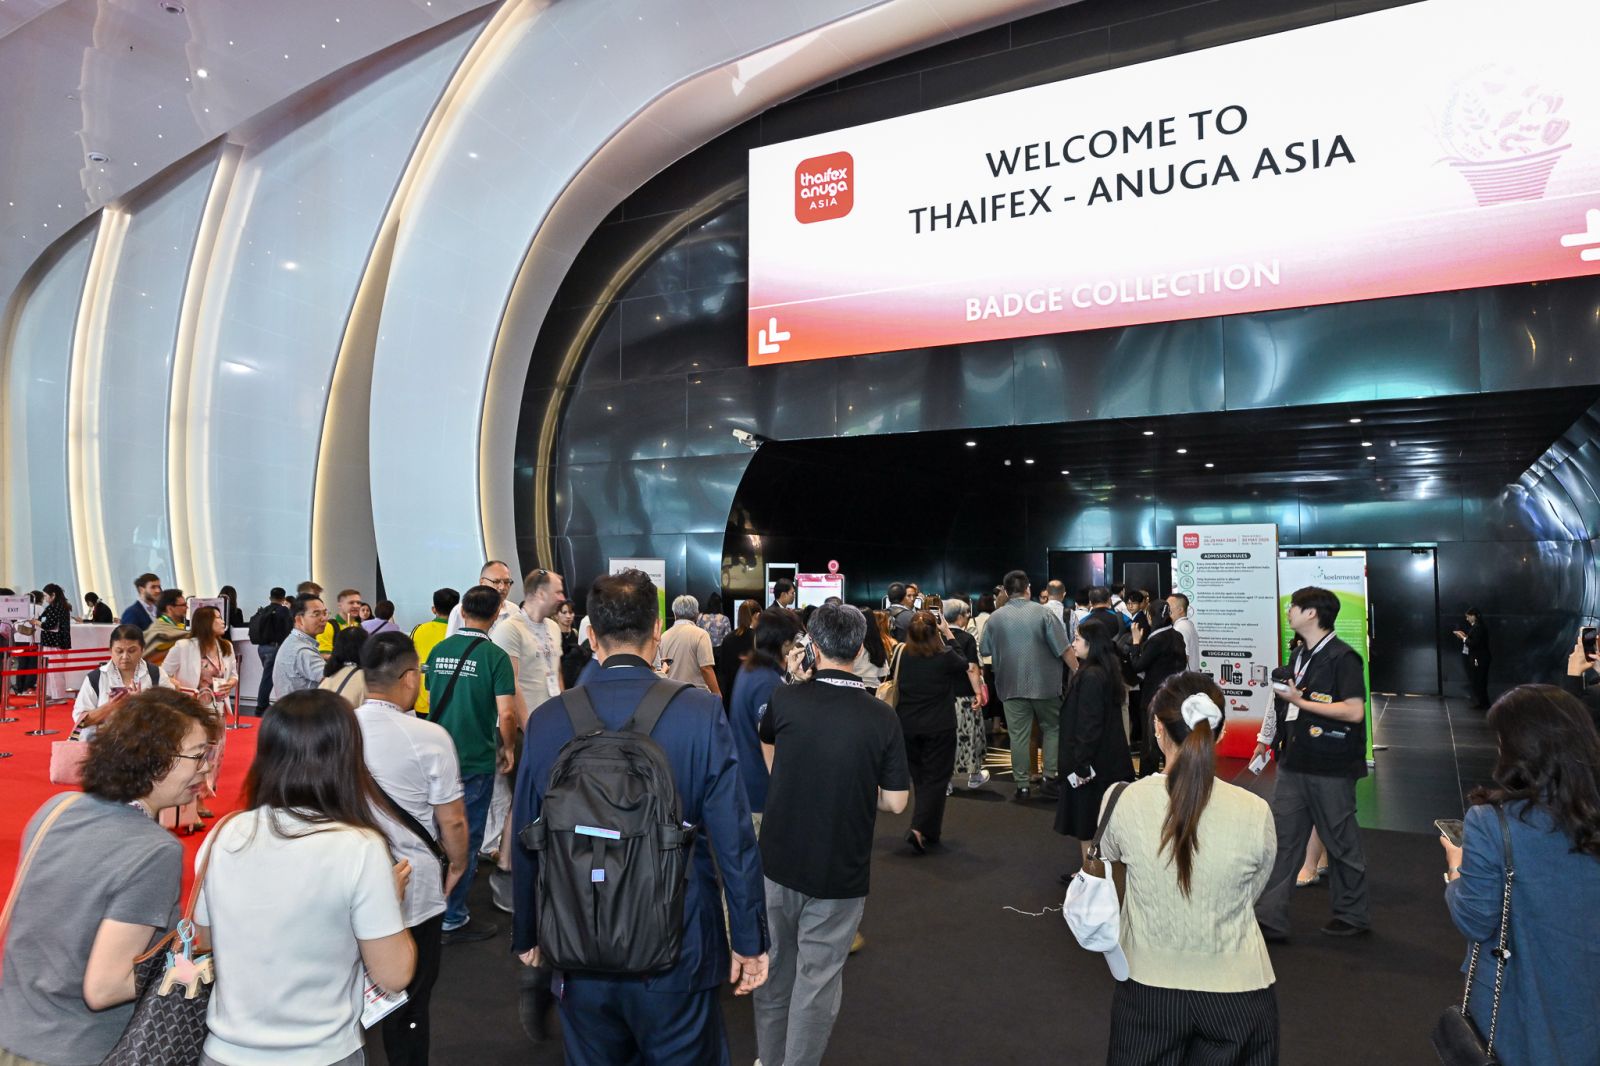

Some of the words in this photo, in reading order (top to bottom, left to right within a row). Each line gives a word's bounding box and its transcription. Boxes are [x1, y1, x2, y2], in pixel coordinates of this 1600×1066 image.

[986, 117, 1177, 178] WELCOME
[1189, 105, 1248, 141] TO
[800, 167, 848, 187] thaifex
[800, 181, 848, 199] anuga
[909, 186, 1052, 233] THAIFEX
[1088, 155, 1239, 206] ANUGA
[1252, 135, 1356, 180] ASIA
[809, 197, 838, 210] ASIA
[965, 287, 1063, 321] BADGE
[1071, 259, 1280, 309] COLLECTION
